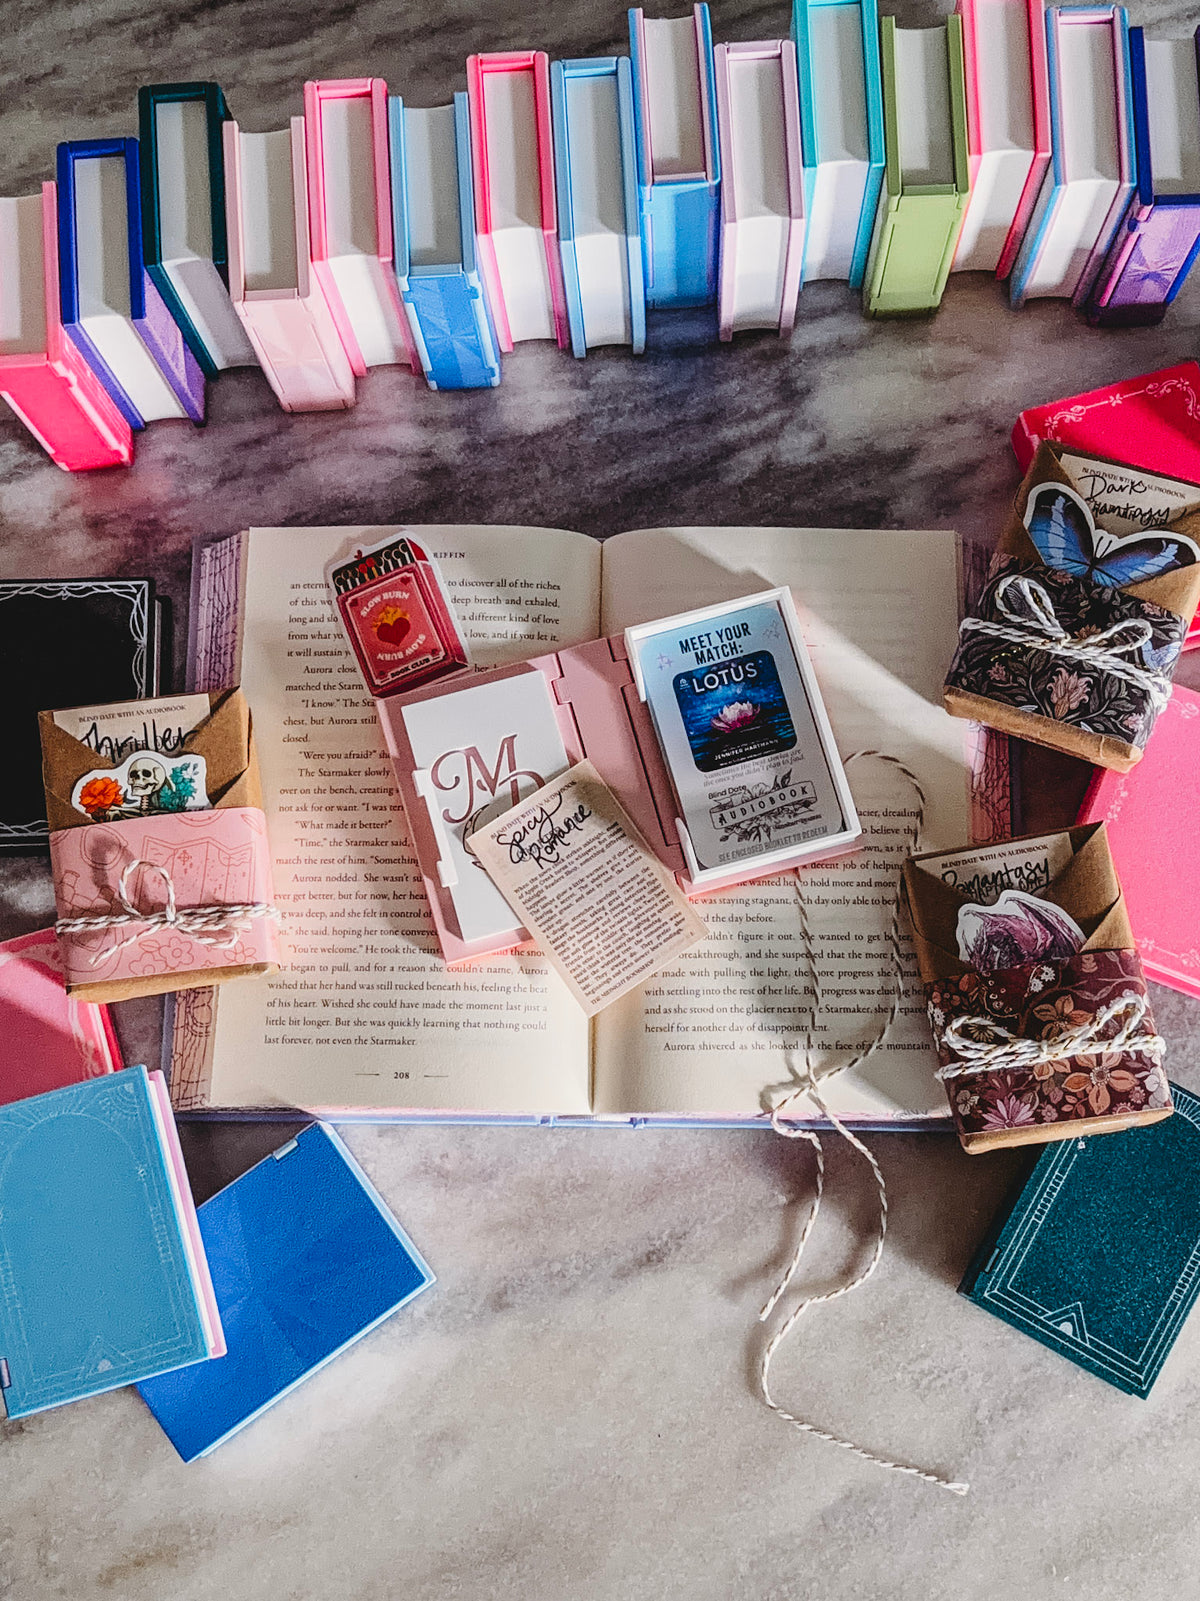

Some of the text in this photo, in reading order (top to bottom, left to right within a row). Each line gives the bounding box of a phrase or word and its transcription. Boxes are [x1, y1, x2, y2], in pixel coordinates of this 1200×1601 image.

[1078, 474, 1148, 501] Dark
[458, 577, 496, 588] discover
[495, 577, 507, 588] all
[508, 578, 519, 589] of
[519, 579, 535, 589] the
[535, 580, 561, 591] riches
[361, 590, 410, 618] SLOW BURN
[450, 594, 561, 609] deep breath and exhaled,
[469, 628, 560, 645] love, and if you let it,
[679, 622, 752, 654] MEET YOUR
[694, 642, 744, 665] MATCH:
[390, 658, 430, 678] BOOK CLUB
[692, 662, 758, 692] LOTUS
[100, 714, 116, 722] DATE
[117, 711, 134, 719] WITH
[282, 714, 378, 726] chest, but Aurora still
[80, 718, 198, 763] Thriller
[313, 785, 328, 795] the
[329, 784, 358, 795] bench,
[359, 785, 395, 797] creating
[708, 785, 746, 800] Blind Date
[718, 786, 808, 826] AUDIOBOOK
[294, 819, 393, 830] "What made it better?"
[497, 792, 562, 864] Spicy
[529, 804, 592, 870] Romance
[718, 852, 730, 862] SEE
[732, 844, 764, 859] ENCLOSED
[764, 836, 792, 850] BOOKLET
[800, 826, 828, 840] REDEEM
[810, 858, 858, 872] decent job
[942, 860, 962, 869] BLIND
[962, 857, 978, 866] DATE
[979, 853, 996, 862] WITH
[942, 858, 1052, 904] Romantasy
[711, 912, 776, 925] the day before.
[290, 962, 316, 975] began
[330, 962, 351, 975] pull,
[354, 962, 371, 972] and
[373, 962, 387, 972] for
[397, 965, 426, 973] reason
[428, 962, 444, 973] she
[446, 963, 484, 974] couldn't
[486, 967, 514, 975] name,
[517, 963, 548, 976] Aurora
[661, 966, 810, 980] made with pulling the light, the
[838, 970, 874, 980] progress
[644, 984, 802, 999] with settling into the rest of her life.
[821, 988, 875, 999] progress was
[644, 1020, 757, 1033] herself for another day of
[264, 1034, 280, 1045] last
[281, 1033, 314, 1045] forever,
[354, 1035, 369, 1046] the
[370, 1035, 416, 1046] Starmaker.
[663, 1041, 696, 1051] Aurora
[698, 1040, 736, 1051] shivered
[751, 1040, 766, 1051] she
[768, 1037, 799, 1051] looked
[817, 1039, 854, 1051] the face
[886, 1040, 932, 1051] mountain
[393, 1072, 410, 1080] 208
